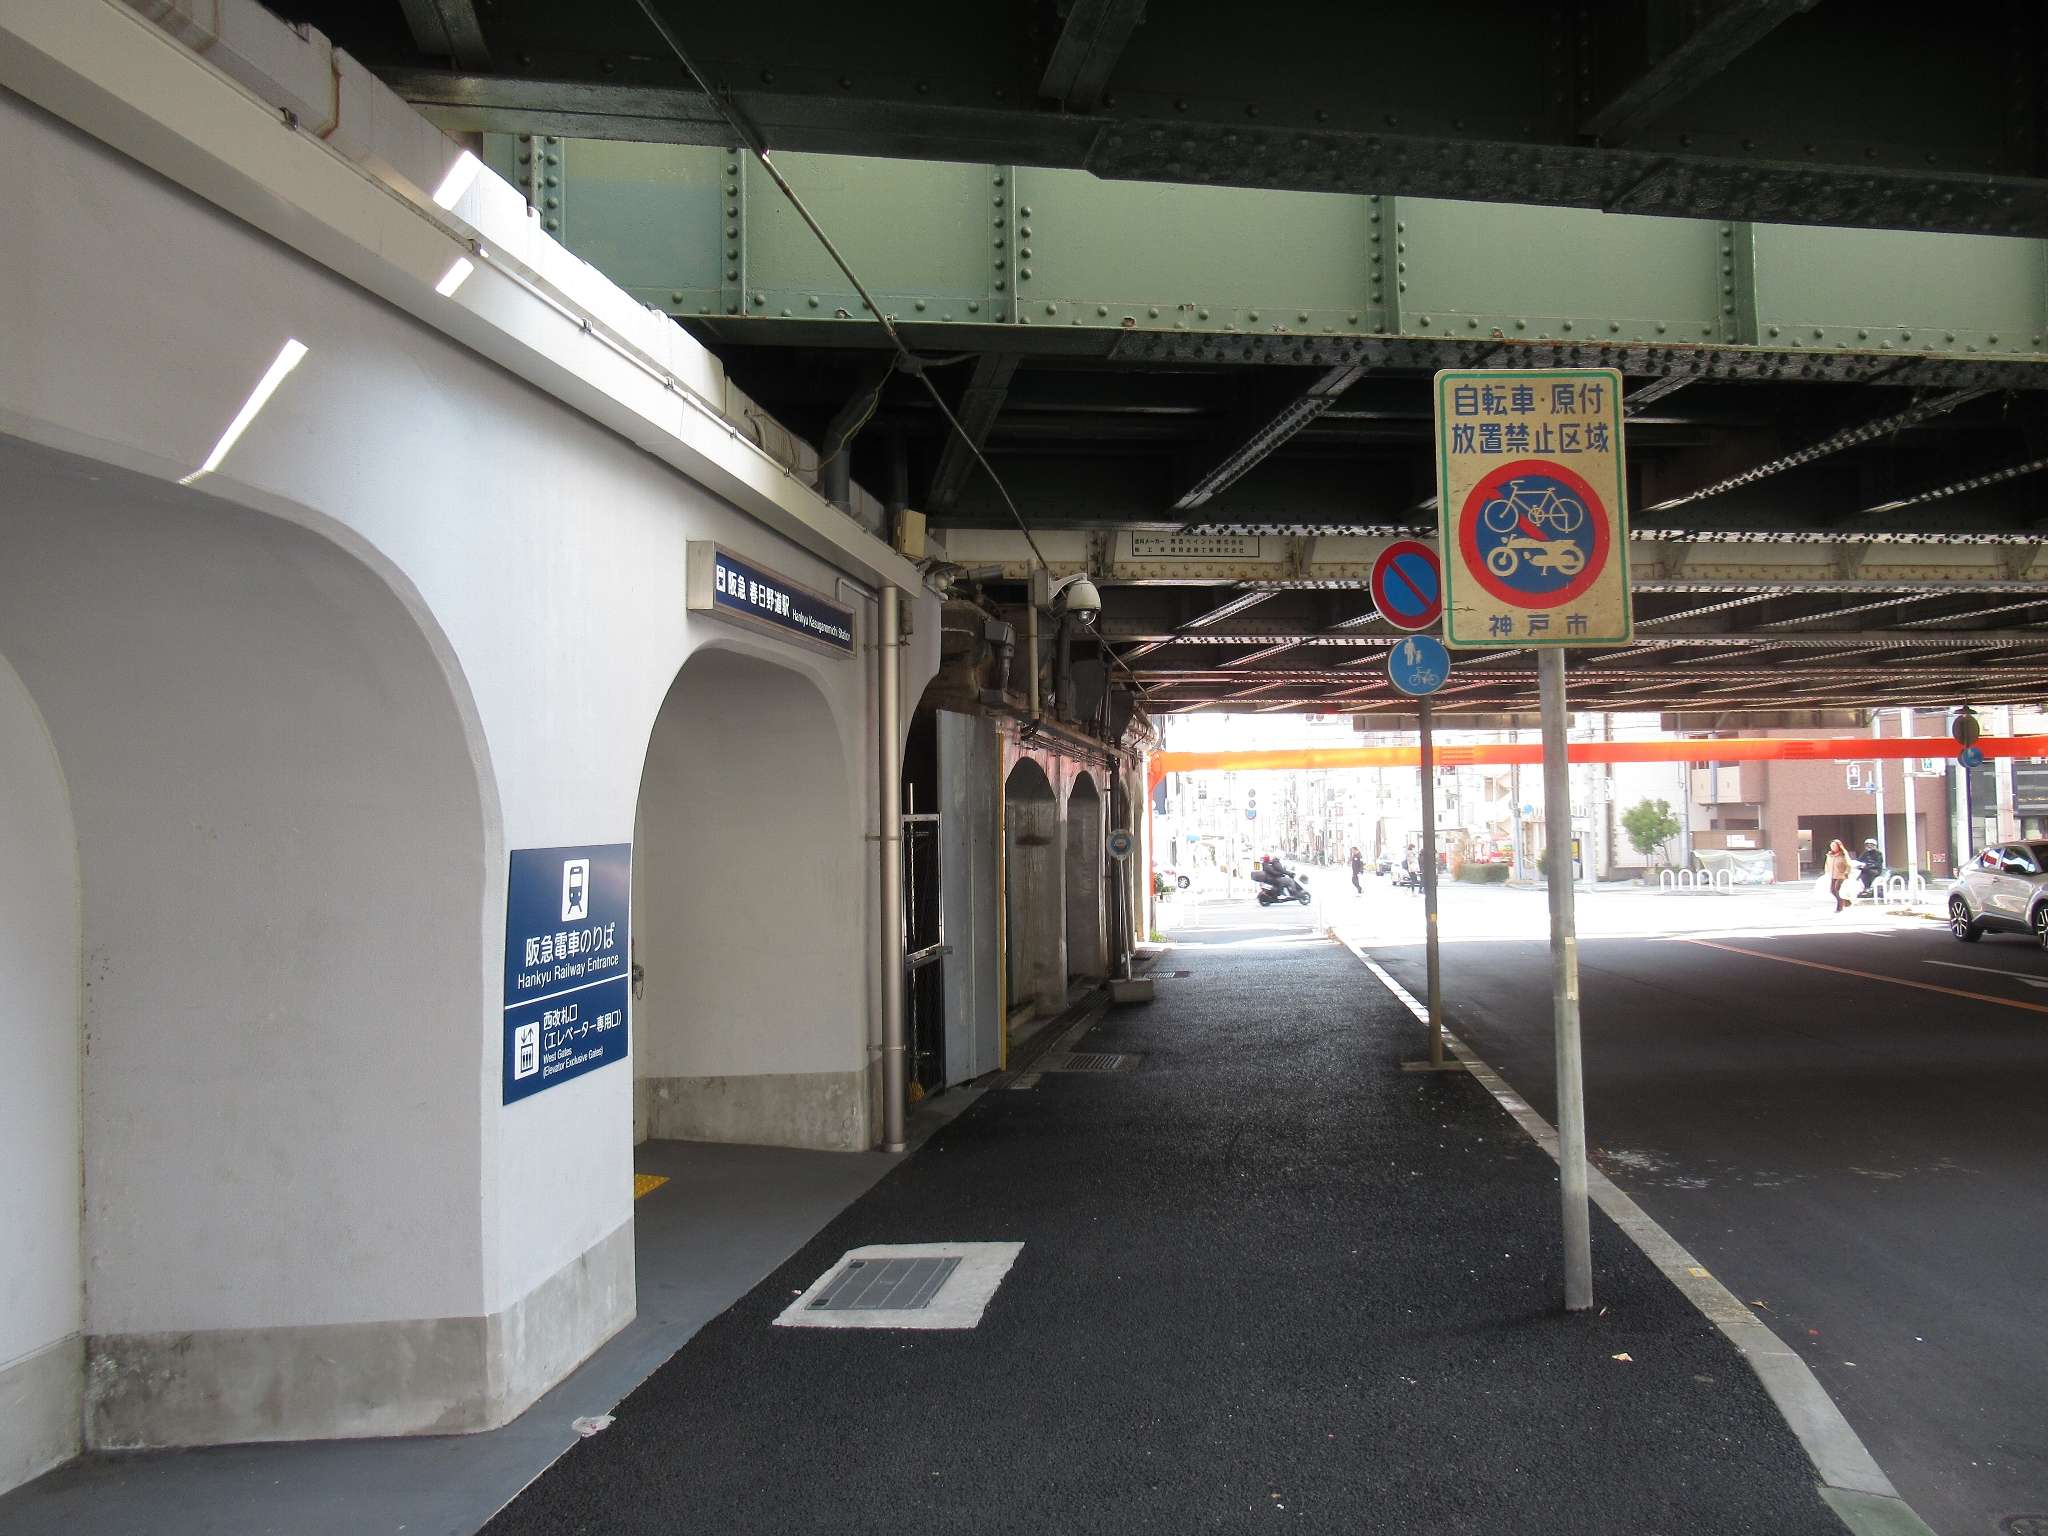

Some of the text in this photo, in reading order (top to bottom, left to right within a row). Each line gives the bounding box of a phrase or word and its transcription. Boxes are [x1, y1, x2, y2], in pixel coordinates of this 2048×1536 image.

[1454, 384, 1604, 416] 自転車・原付
[1451, 423, 1610, 454] 放置禁止区域
[727, 570, 790, 617] 阪急 春日野道駅
[1488, 614, 1588, 637] 神戸市
[525, 922, 615, 967] 阪急電車のりば
[518, 953, 619, 991] Hankyu Railway Entrance
[543, 1003, 578, 1030] 西改札口
[543, 1047, 572, 1065] West Gates
